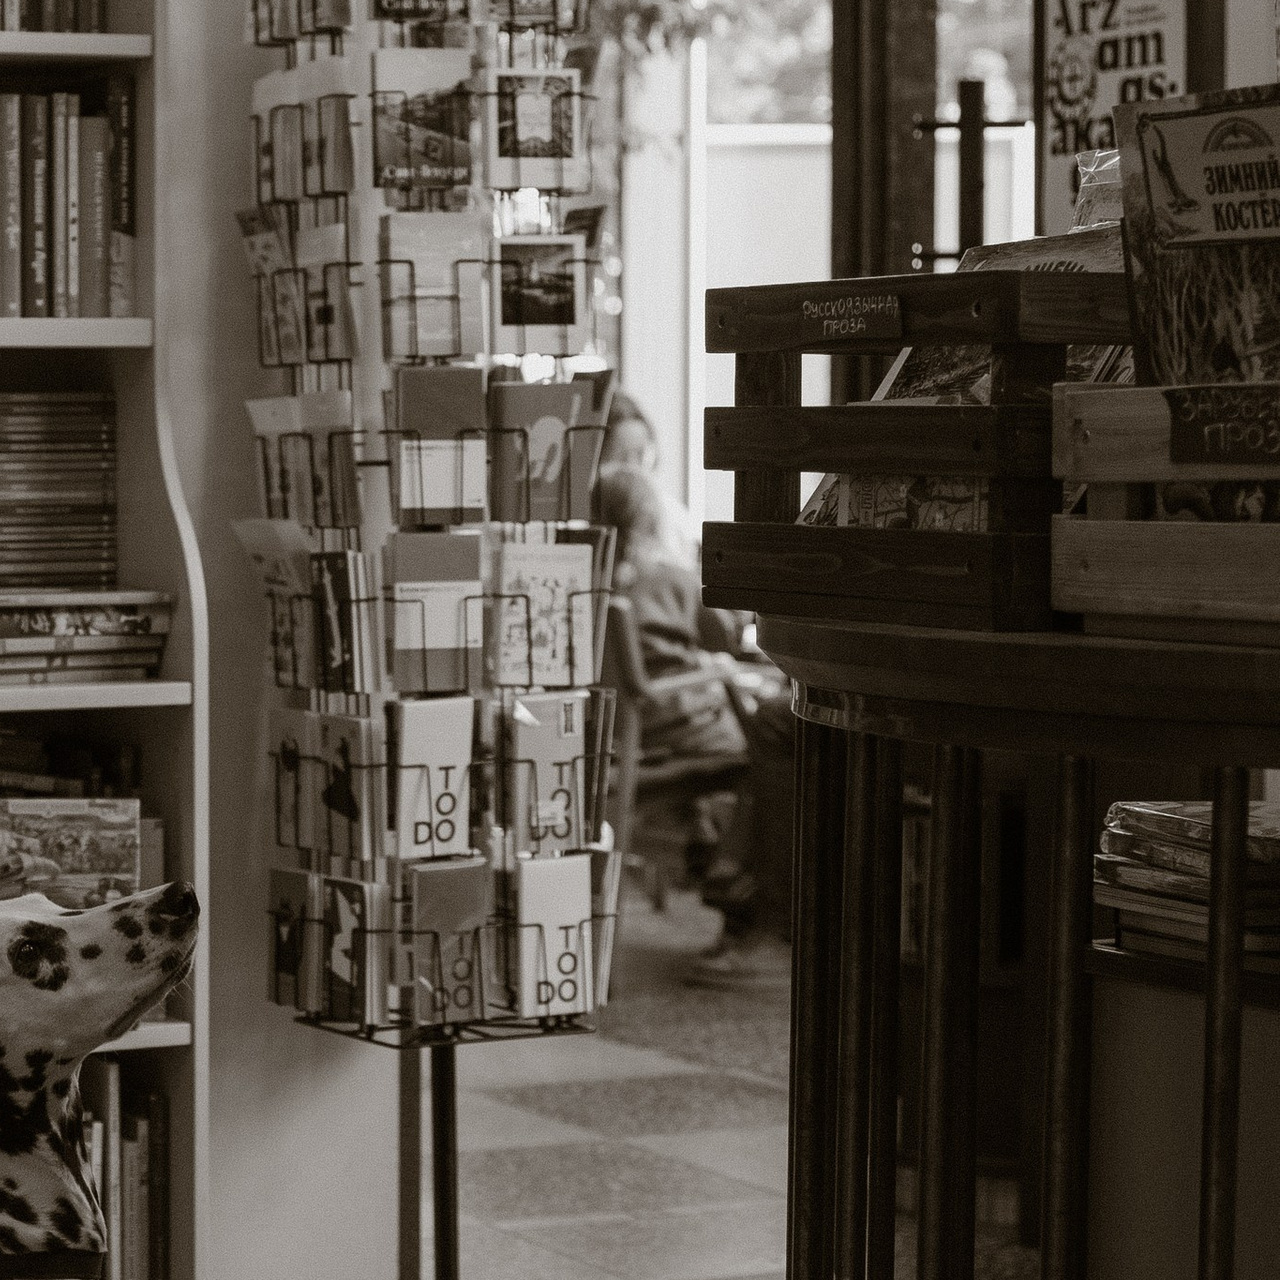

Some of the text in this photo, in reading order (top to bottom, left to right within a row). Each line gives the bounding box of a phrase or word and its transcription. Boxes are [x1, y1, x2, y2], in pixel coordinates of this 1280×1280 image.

[1095, 31, 1163, 71] am
[1202, 153, 1280, 196] ЗИМНИЙ
[822, 316, 867, 336] ПРОЗА
[414, 819, 456, 844] DO
[536, 978, 578, 1004] DO
